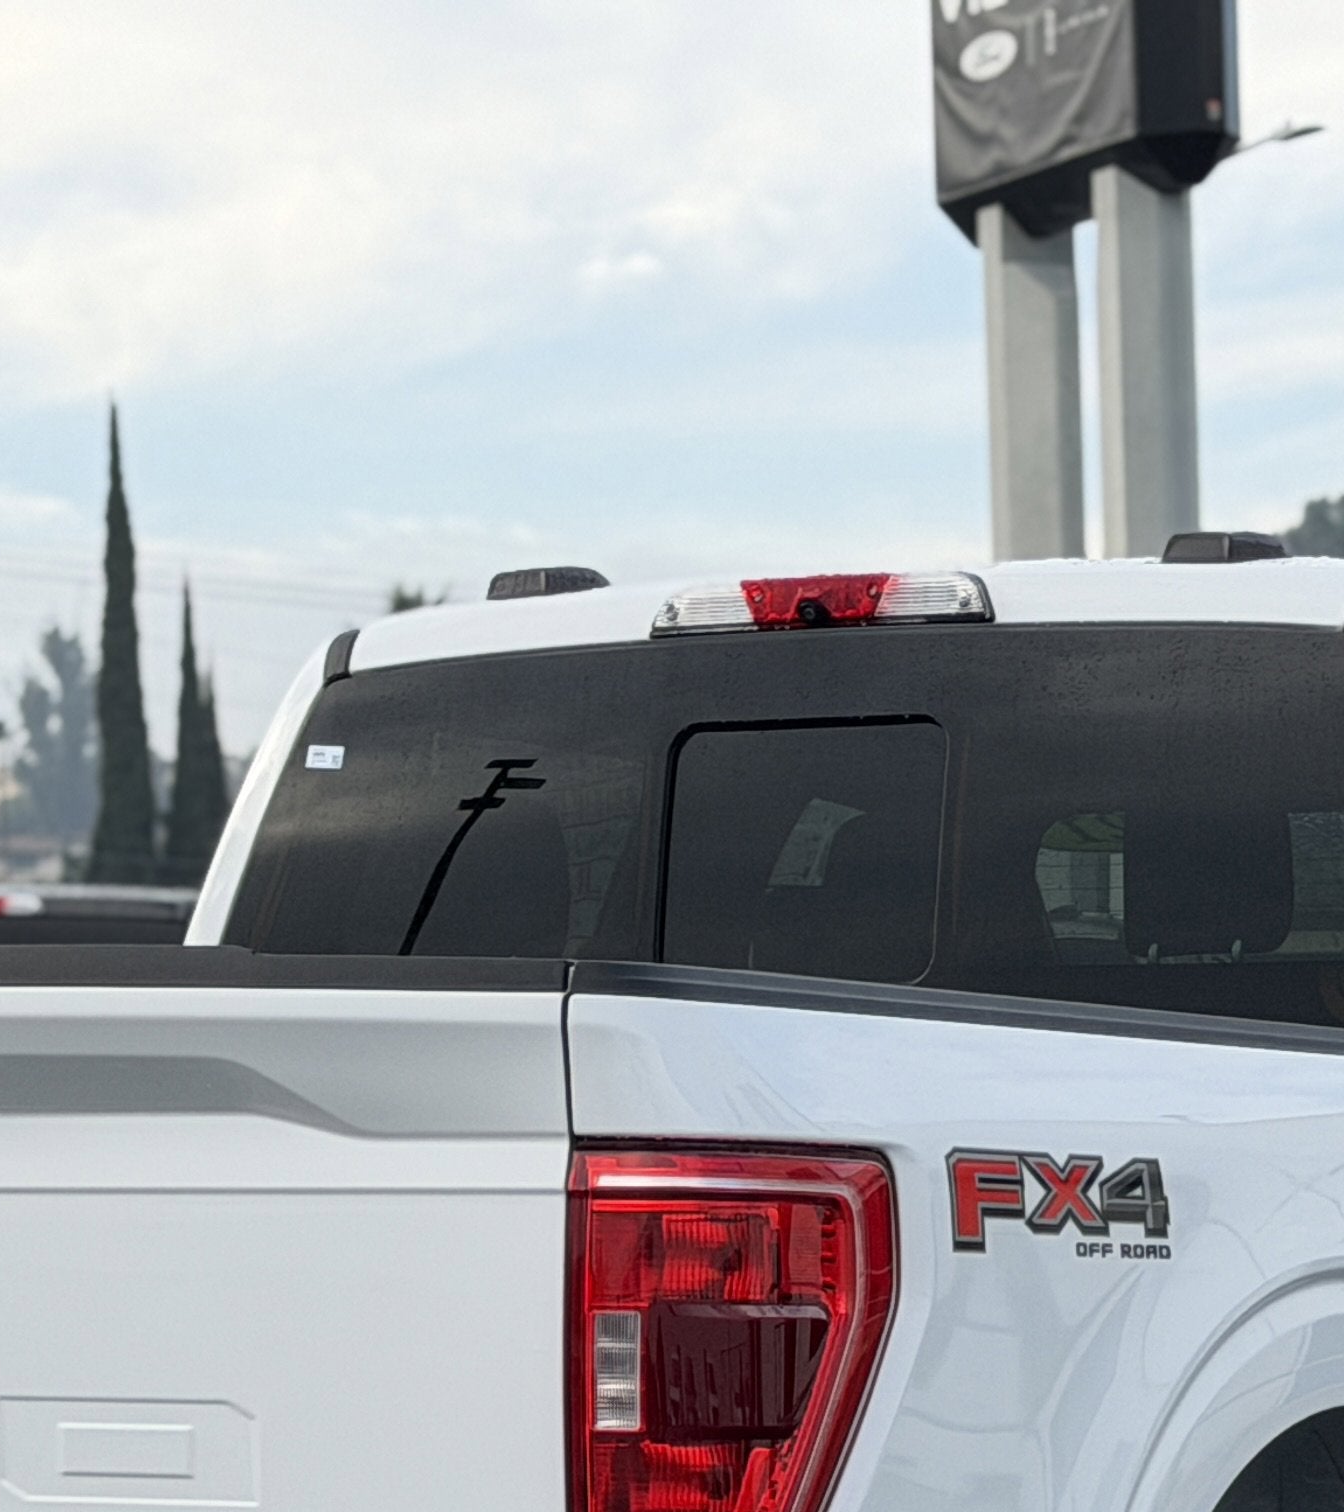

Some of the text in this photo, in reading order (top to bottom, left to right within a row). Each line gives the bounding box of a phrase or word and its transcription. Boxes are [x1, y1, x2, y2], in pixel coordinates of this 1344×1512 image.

[945, 1146, 1170, 1254] FX4
[1075, 1241, 1172, 1260] OFF ROAD
